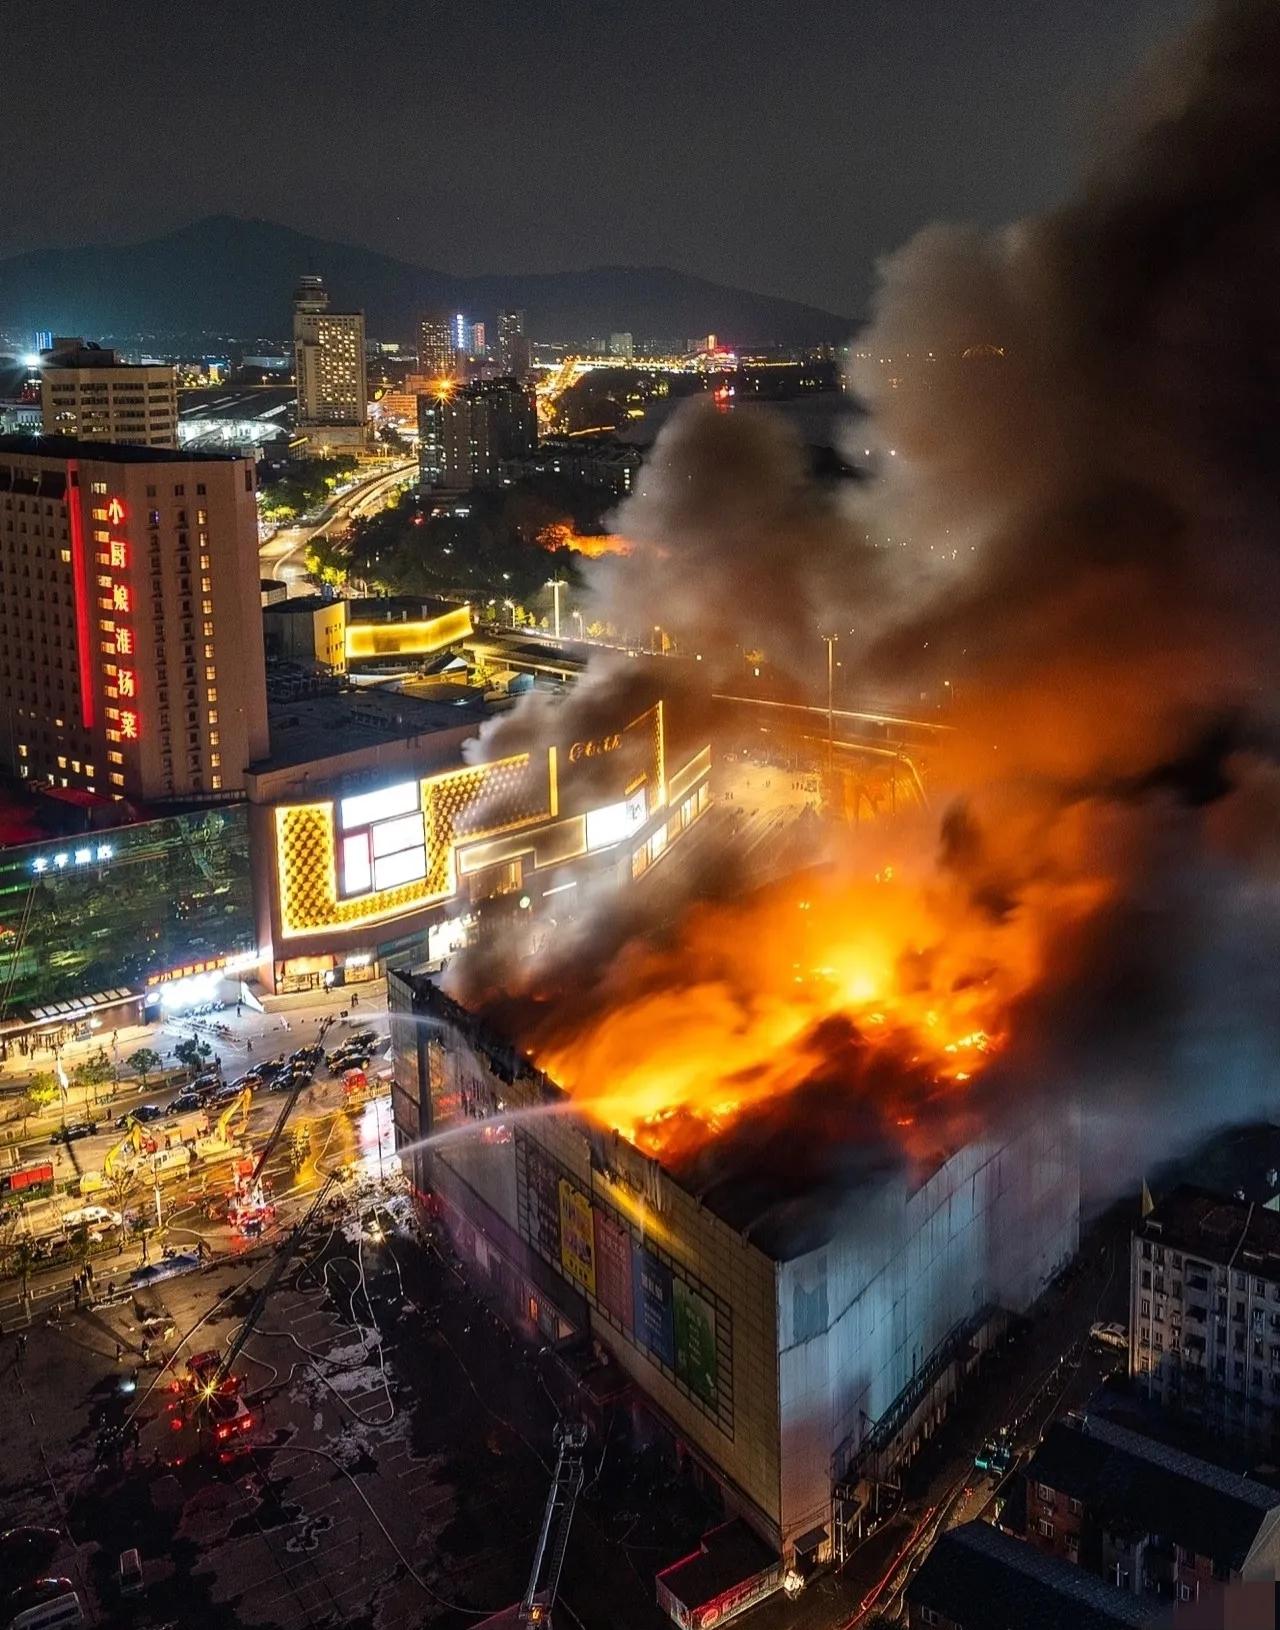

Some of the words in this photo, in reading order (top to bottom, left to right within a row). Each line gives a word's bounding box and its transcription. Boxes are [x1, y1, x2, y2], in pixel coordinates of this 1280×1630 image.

[108, 498, 137, 738] 小厨娘淮扬菜
